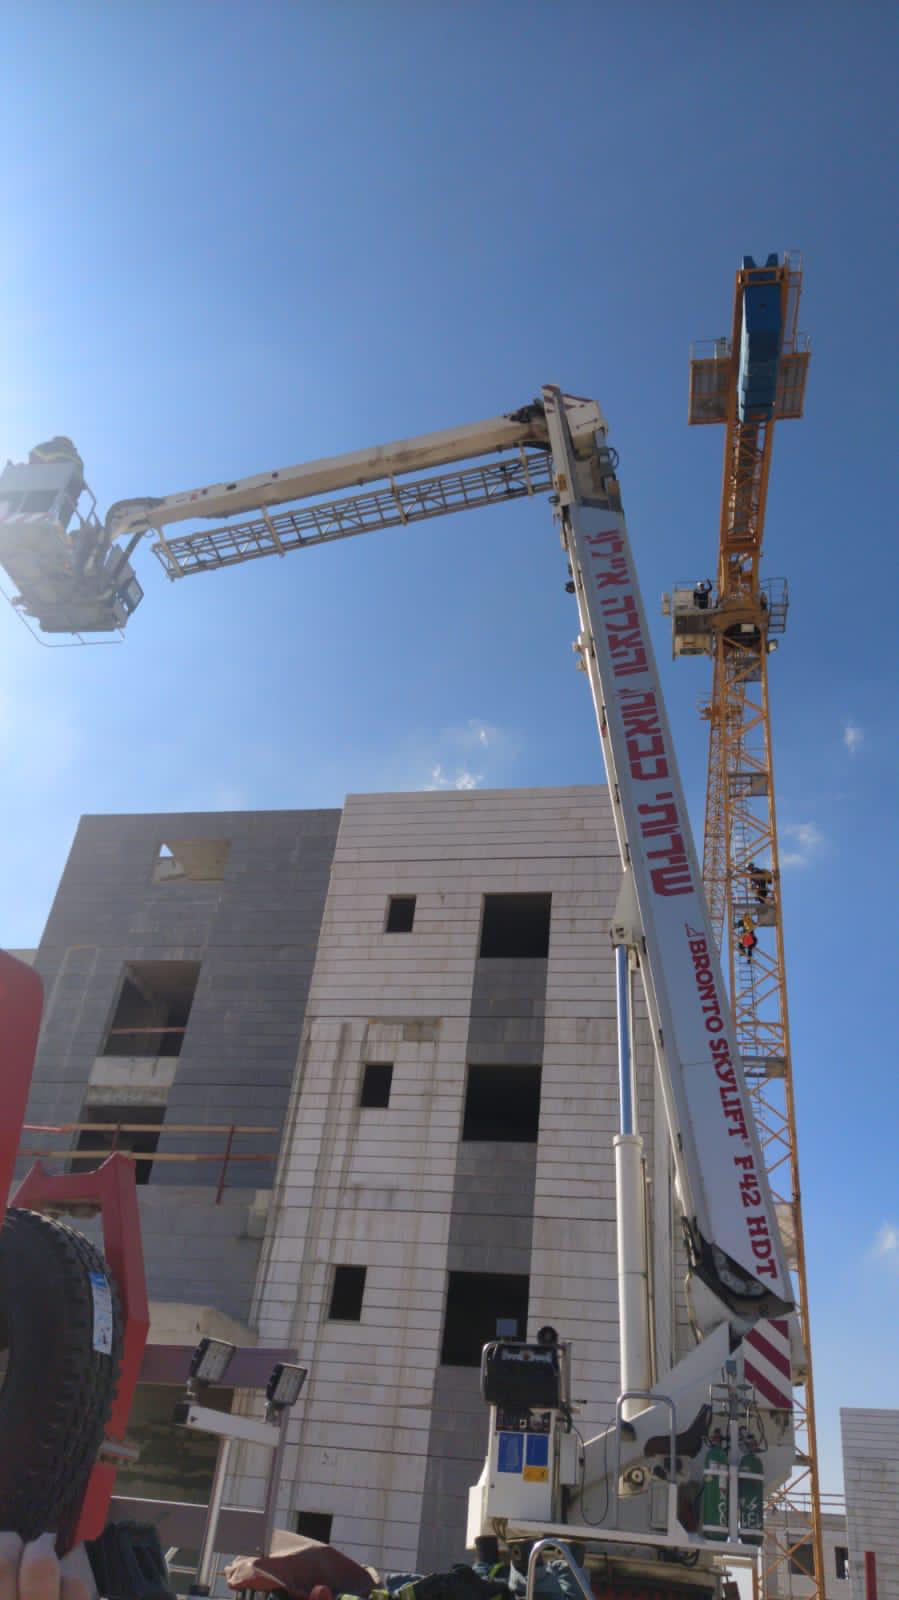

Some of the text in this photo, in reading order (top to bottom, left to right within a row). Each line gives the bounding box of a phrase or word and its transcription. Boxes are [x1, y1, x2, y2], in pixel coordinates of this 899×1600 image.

[600, 594, 650, 678] והצלה
[616, 687, 669, 781] כבאות
[637, 791, 694, 898] שירותי
[688, 938, 778, 1279] BRONTO SKYLIFT F42 HDT
